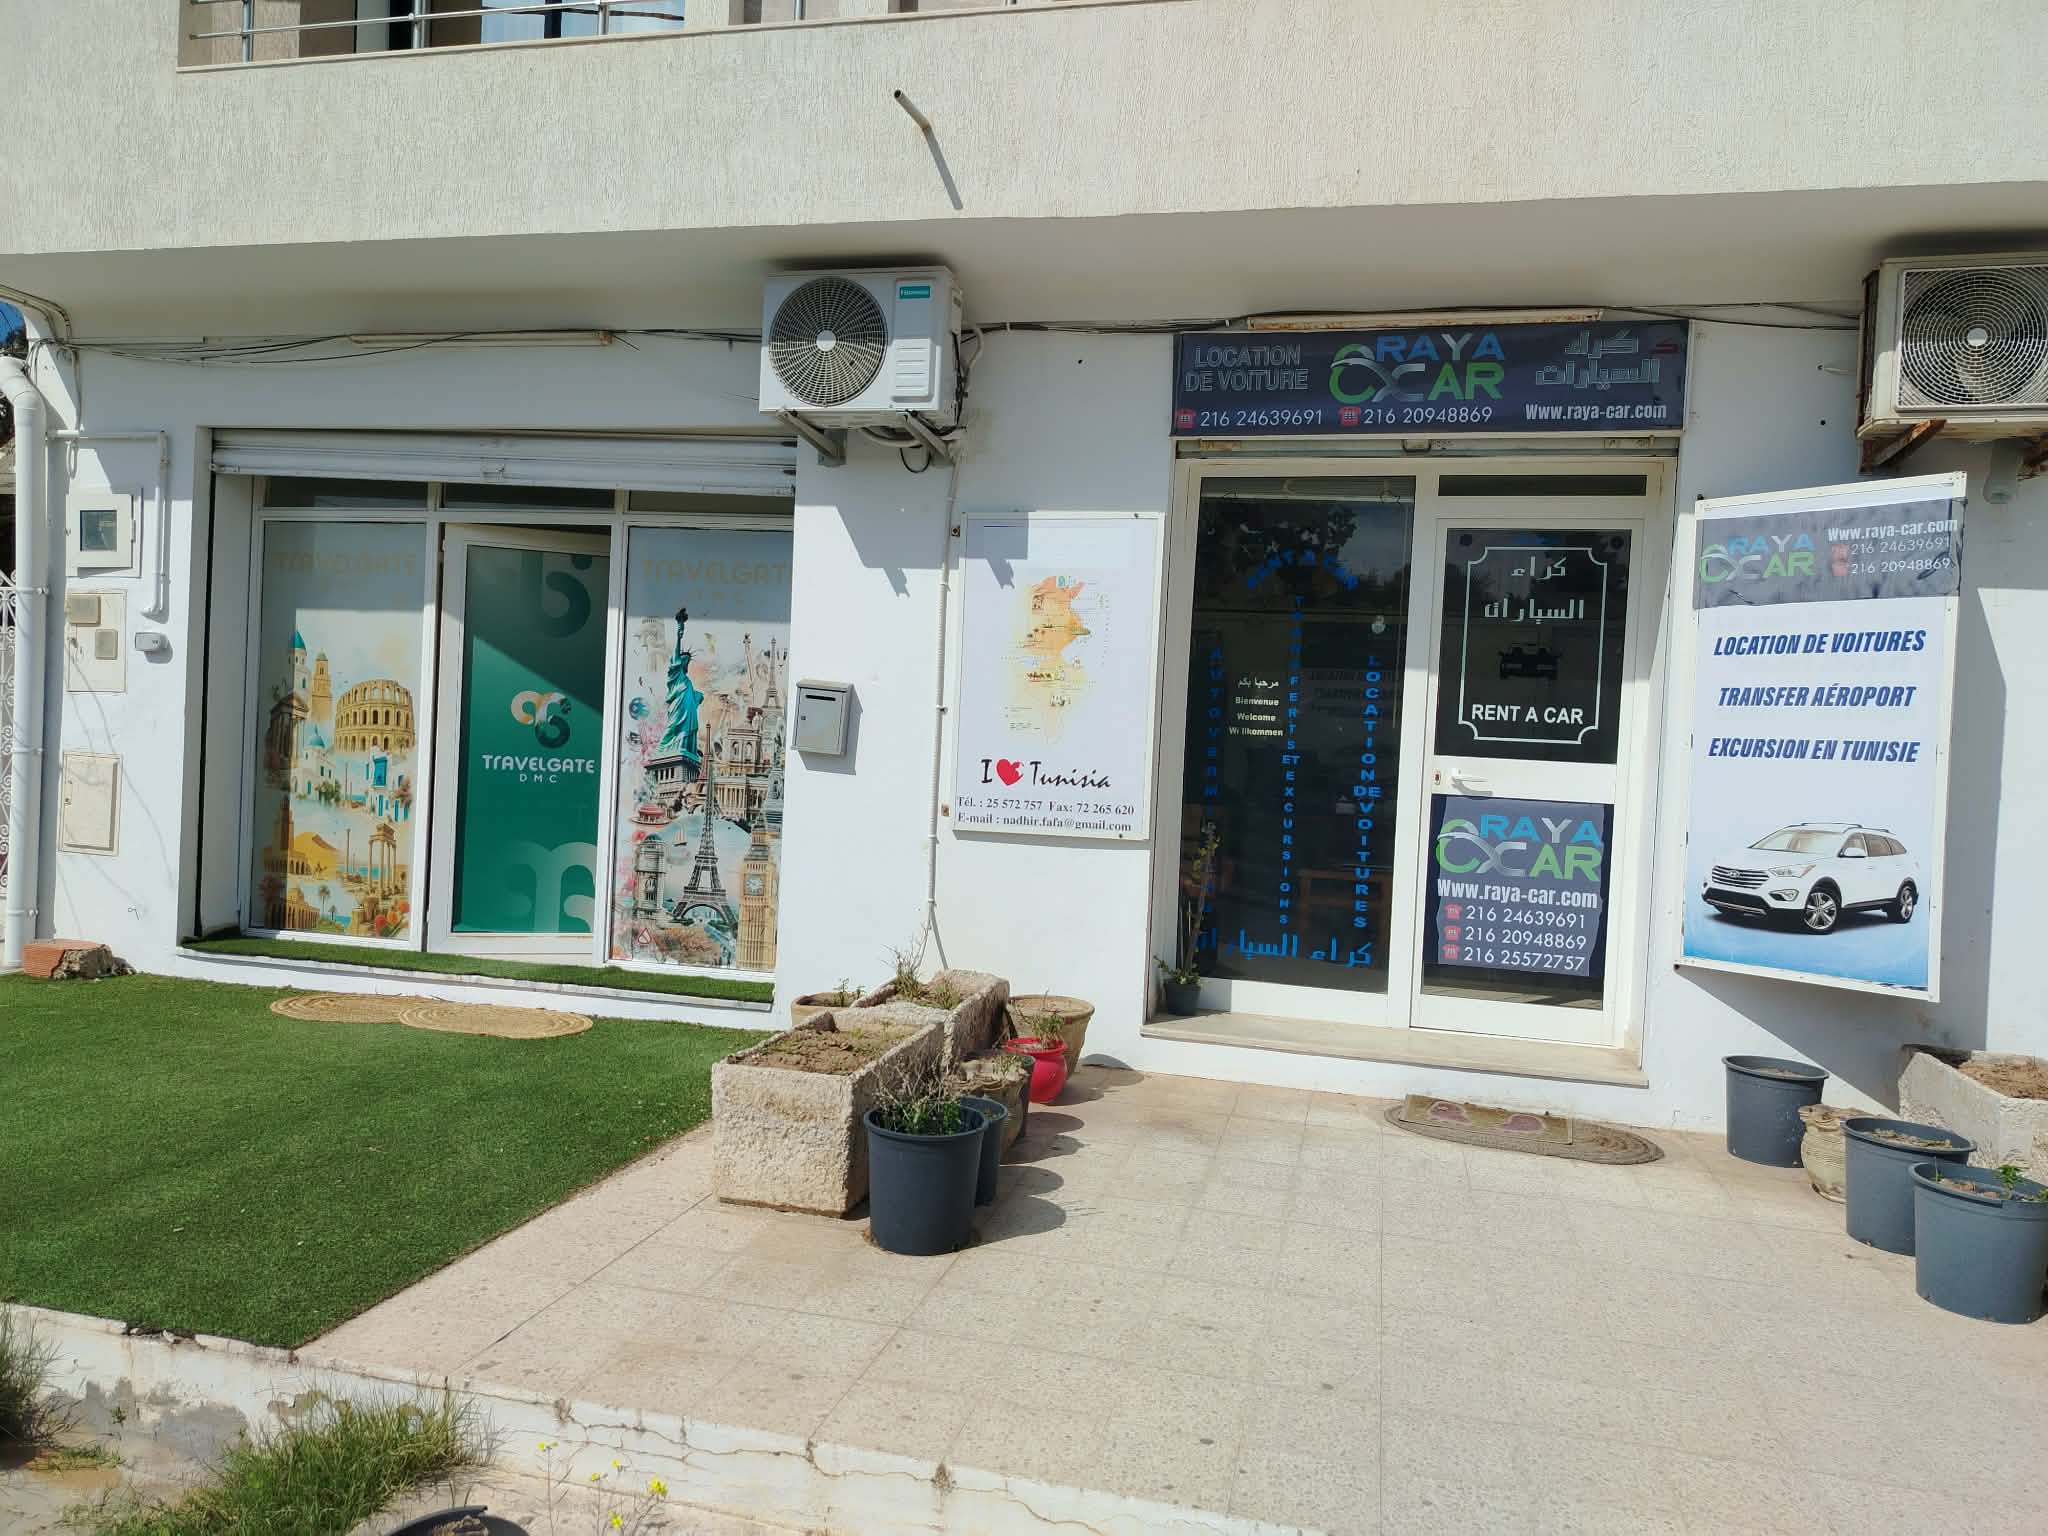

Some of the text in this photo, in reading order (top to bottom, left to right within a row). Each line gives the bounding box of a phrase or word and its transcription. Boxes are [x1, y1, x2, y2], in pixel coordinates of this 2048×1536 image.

[1194, 344, 1301, 368] LOCATION
[1376, 332, 1505, 363] RAYA
[1184, 368, 1310, 392] DE VOITURE
[1388, 362, 1505, 402] CAR
[1535, 358, 1661, 390] السيارات
[1200, 409, 1323, 427] 216 24639691
[1363, 406, 1493, 424] 216 20948869
[1525, 403, 1667, 422] Www.raya-car.com
[1828, 519, 1958, 542] Www.raya-car.com
[1727, 533, 1816, 555] RAYA
[1851, 536, 1951, 555] 216 24639691
[1511, 555, 1567, 582] كراء
[1737, 552, 1817, 580] CAR
[1851, 557, 1951, 575] 216 20948869
[1484, 597, 1585, 625] السيارات
[1713, 629, 1928, 656] LOCATION DE VOITURES
[1235, 696, 1279, 706] Bienvenue
[1718, 682, 1917, 707] TRANSFER AÉROPORT
[1237, 712, 1277, 721] Welcome
[1471, 703, 1584, 725] RENT A CAR
[1281, 754, 1301, 767] ET
[1708, 737, 1921, 763] EXCURSION EN TUNISIE
[981, 758, 1112, 789] I Tunisia
[1352, 655, 1382, 929] LOCATION DE VOITURES
[958, 796, 977, 808] Tél.
[986, 799, 999, 809] 25
[1001, 799, 1021, 810] 572
[1024, 800, 1043, 811] 757
[1049, 801, 1073, 813] Fax:
[1076, 802, 1090, 813] 72
[1092, 803, 1112, 814] 265
[1115, 804, 1134, 815] 620
[958, 811, 993, 824] E-mail
[1003, 815, 1132, 832] nadhir.fafa@gmail.com
[1479, 813, 1605, 848] RAYA
[1279, 770, 1296, 926] EXCURSIONS
[1492, 842, 1601, 881] CAR
[1437, 878, 1598, 909] Www.raya-car.com
[1465, 905, 1585, 929] 216 24639691
[1464, 926, 1587, 950] 216 20948869
[1310, 936, 1372, 967] كراء
[1463, 946, 1586, 971] 216 25572757
